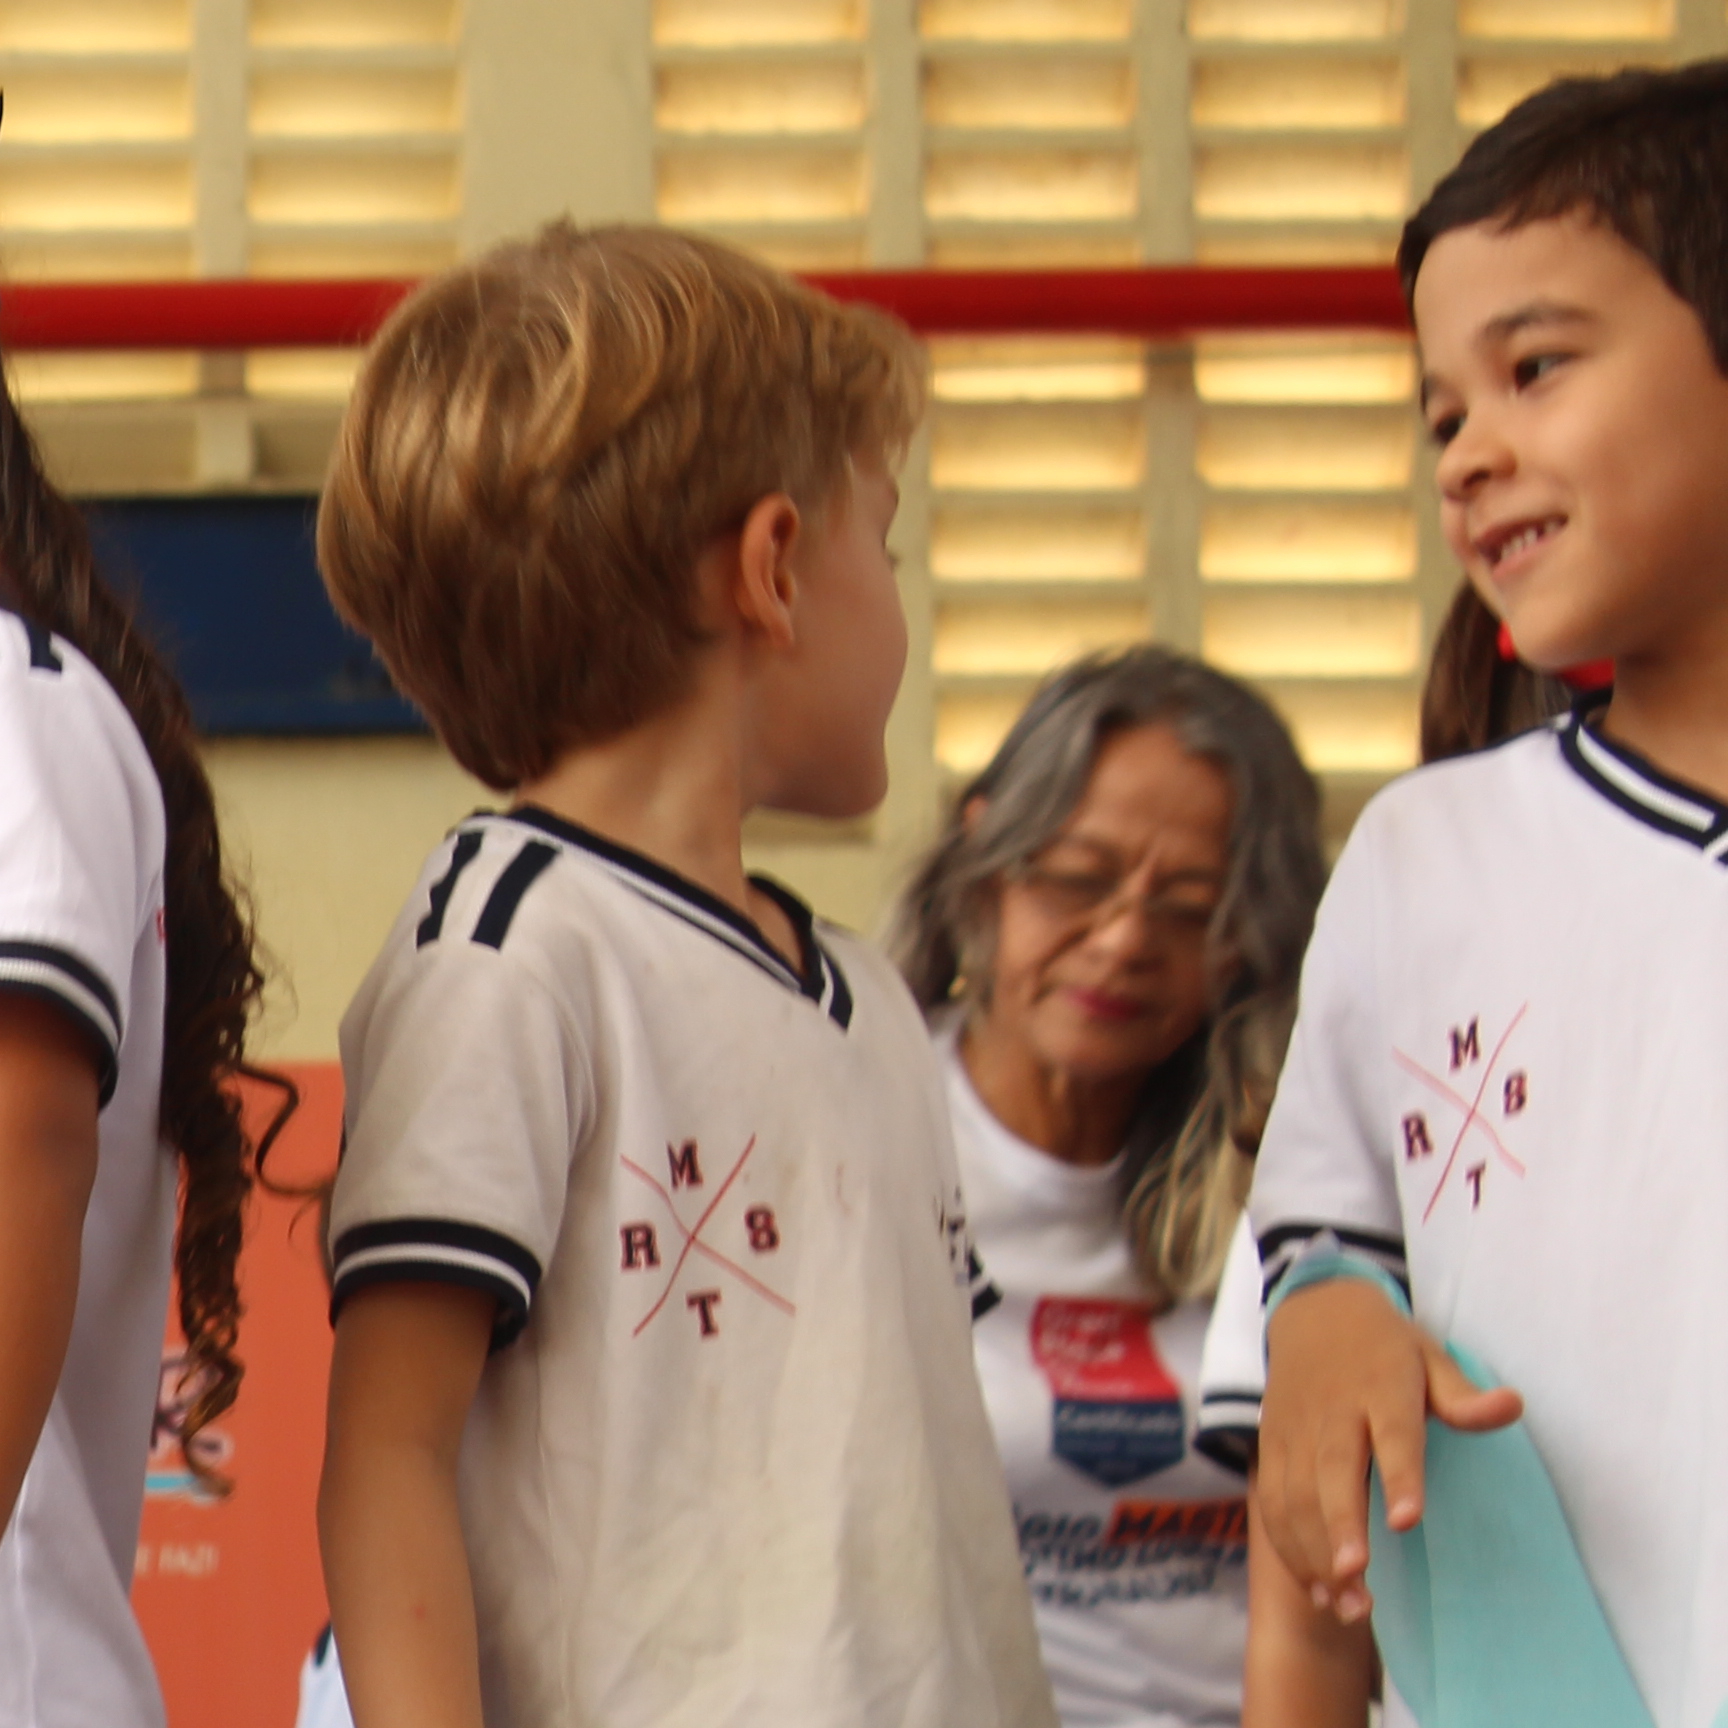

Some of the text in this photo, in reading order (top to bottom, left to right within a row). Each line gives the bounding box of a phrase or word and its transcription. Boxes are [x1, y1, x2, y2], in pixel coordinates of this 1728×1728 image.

[1449, 1015, 1480, 1073] M
[1403, 1112, 1433, 1162] R
[667, 1138, 703, 1191] M
[1466, 1161, 1486, 1208] T
[621, 1221, 660, 1271] R
[686, 1288, 722, 1340] T
